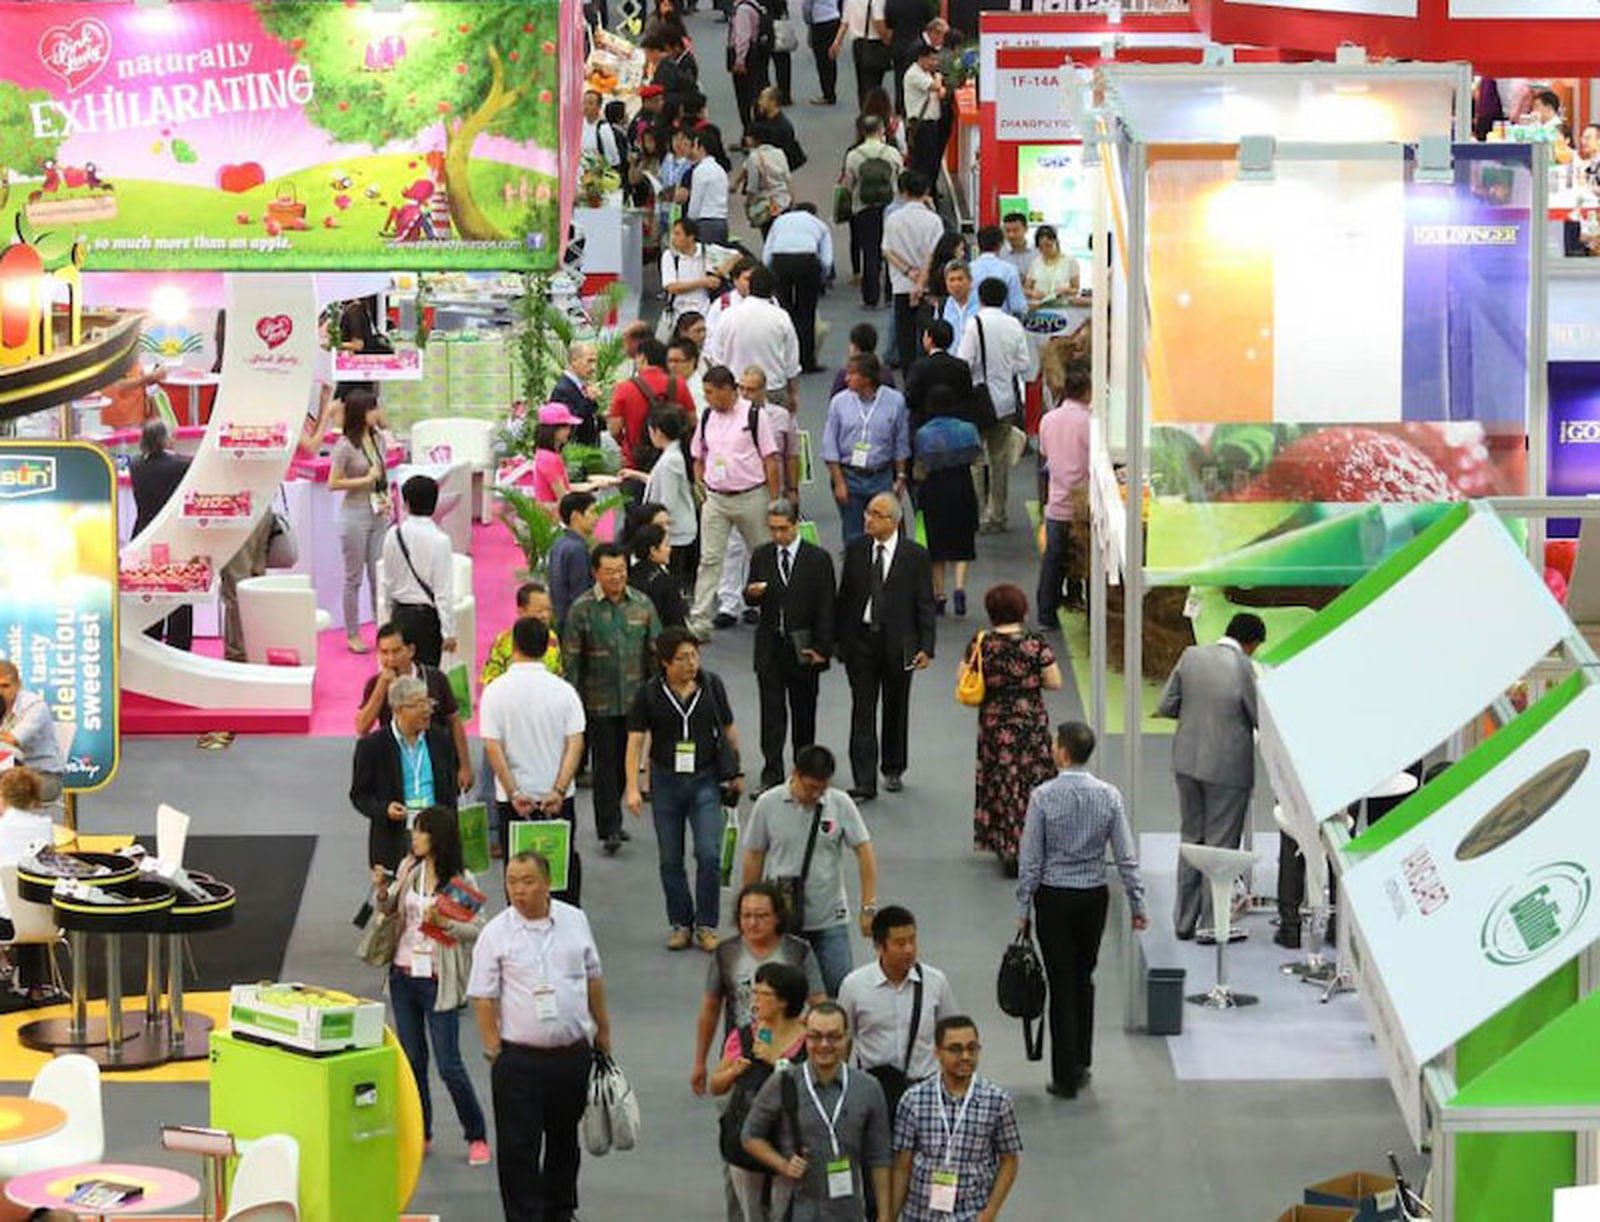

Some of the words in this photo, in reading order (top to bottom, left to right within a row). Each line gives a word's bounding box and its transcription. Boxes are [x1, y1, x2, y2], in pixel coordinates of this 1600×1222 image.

[116, 41, 253, 79] naturally
[1011, 75, 1059, 87] 1F-14A
[29, 63, 315, 138] EXHILARATING
[80, 611, 101, 731] sweetest
